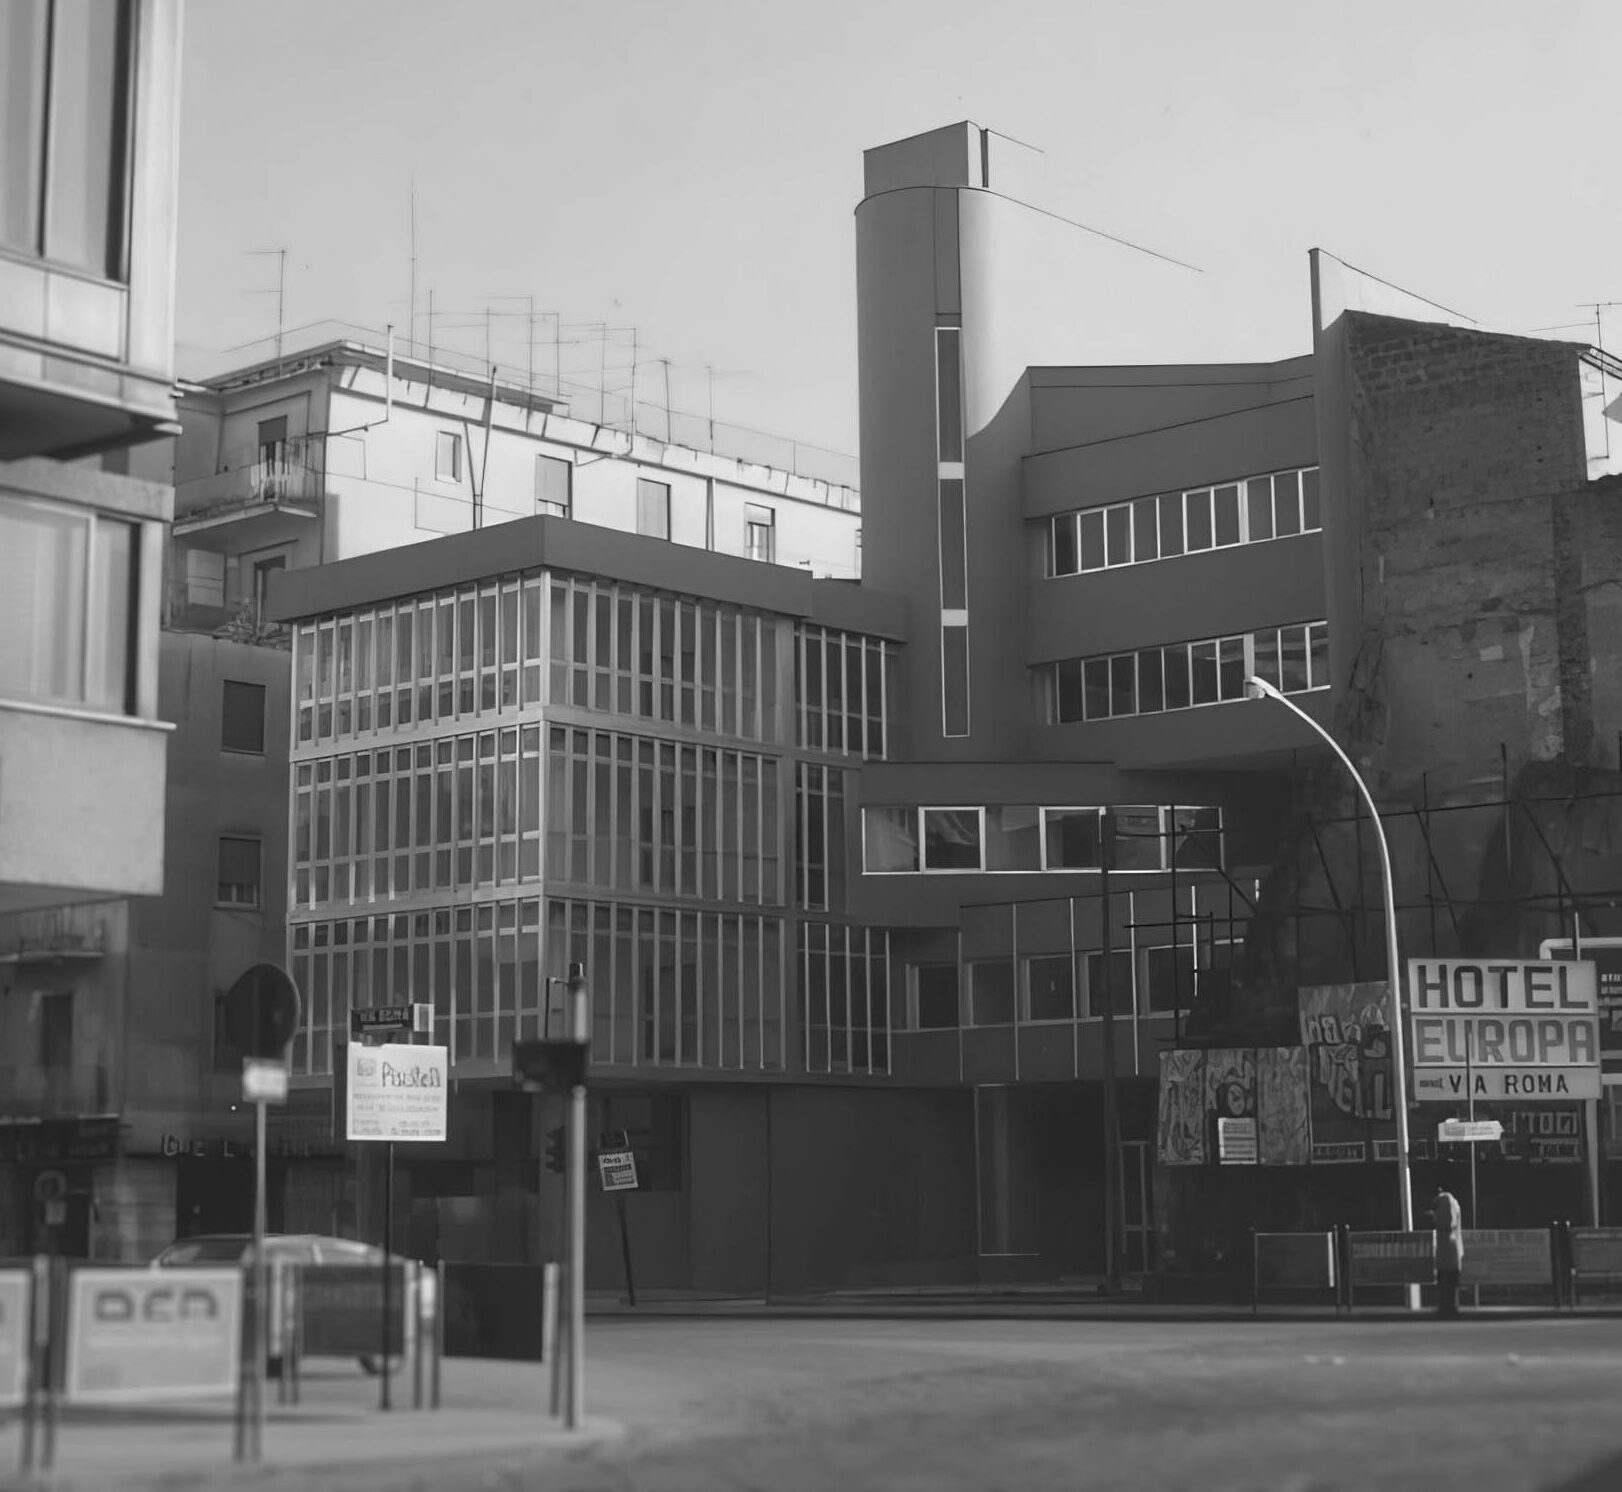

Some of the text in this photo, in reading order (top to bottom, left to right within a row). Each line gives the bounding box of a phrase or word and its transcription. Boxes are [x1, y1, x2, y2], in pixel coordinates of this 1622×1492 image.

[1417, 964, 1589, 1009] HOTEL
[1415, 1018, 1596, 1063] EUROPA
[1449, 1074, 1569, 1094] VA ROMA
